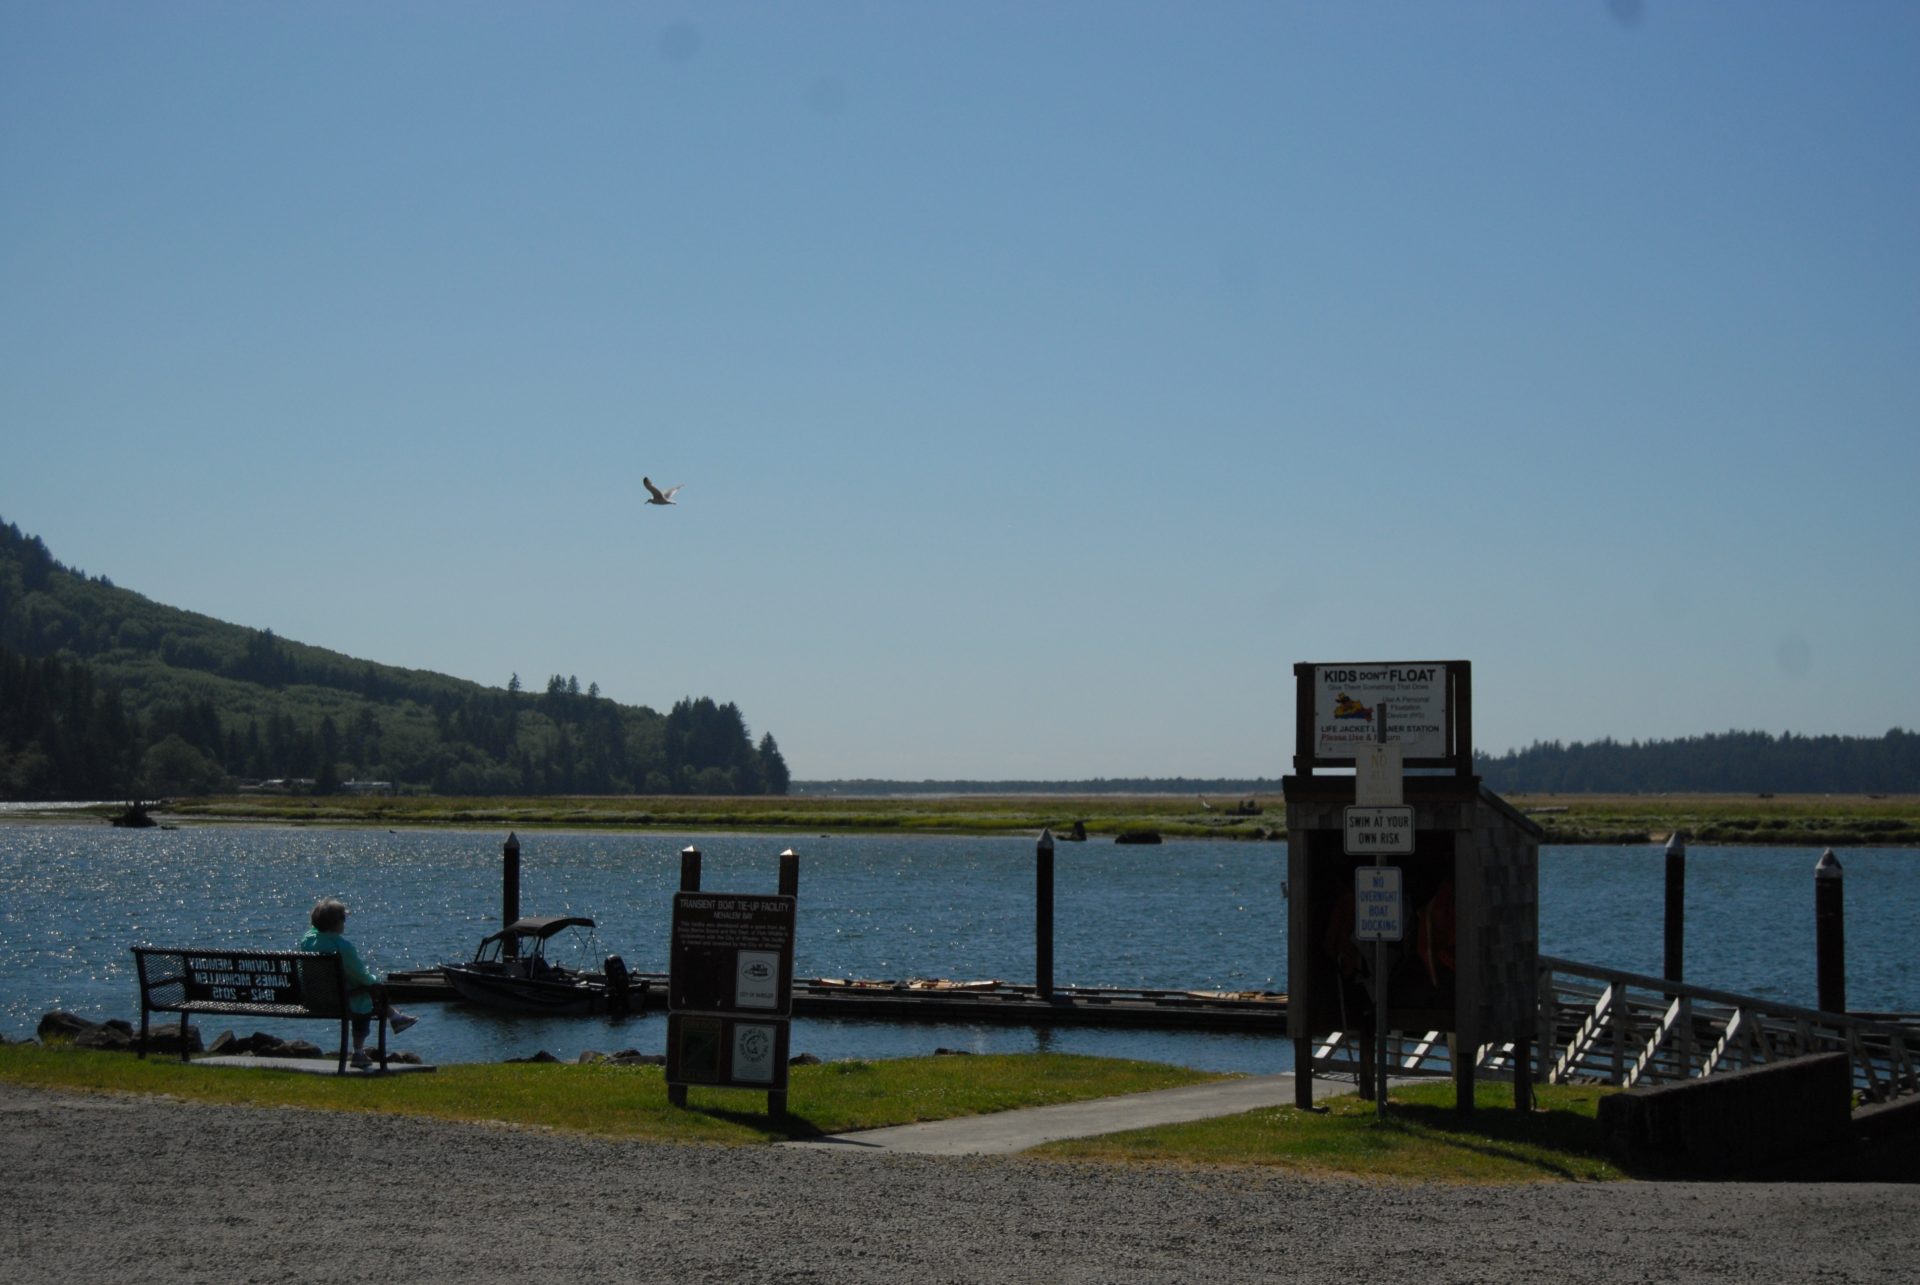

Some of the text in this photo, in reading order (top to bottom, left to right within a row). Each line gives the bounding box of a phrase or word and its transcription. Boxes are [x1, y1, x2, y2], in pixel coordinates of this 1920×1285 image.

[1324, 669, 1436, 683] KIDS DON'T FLOAT
[1321, 725, 1338, 733] LIFE
[1339, 725, 1370, 733] JACKET
[1371, 725, 1405, 733] LNER
[1321, 733, 1347, 741] Please
[1348, 733, 1363, 741] Use
[1349, 816, 1409, 828] SWIM AT YOUR
[1358, 832, 1400, 845] OWN RISK
[1372, 876, 1384, 888] NO
[1360, 891, 1397, 903] OVERNIGHT
[679, 899, 790, 912] TRANSIENT BOAT TIE-UP FACILITY
[1368, 905, 1388, 917] BOAT
[1361, 919, 1397, 931] DOCKING
